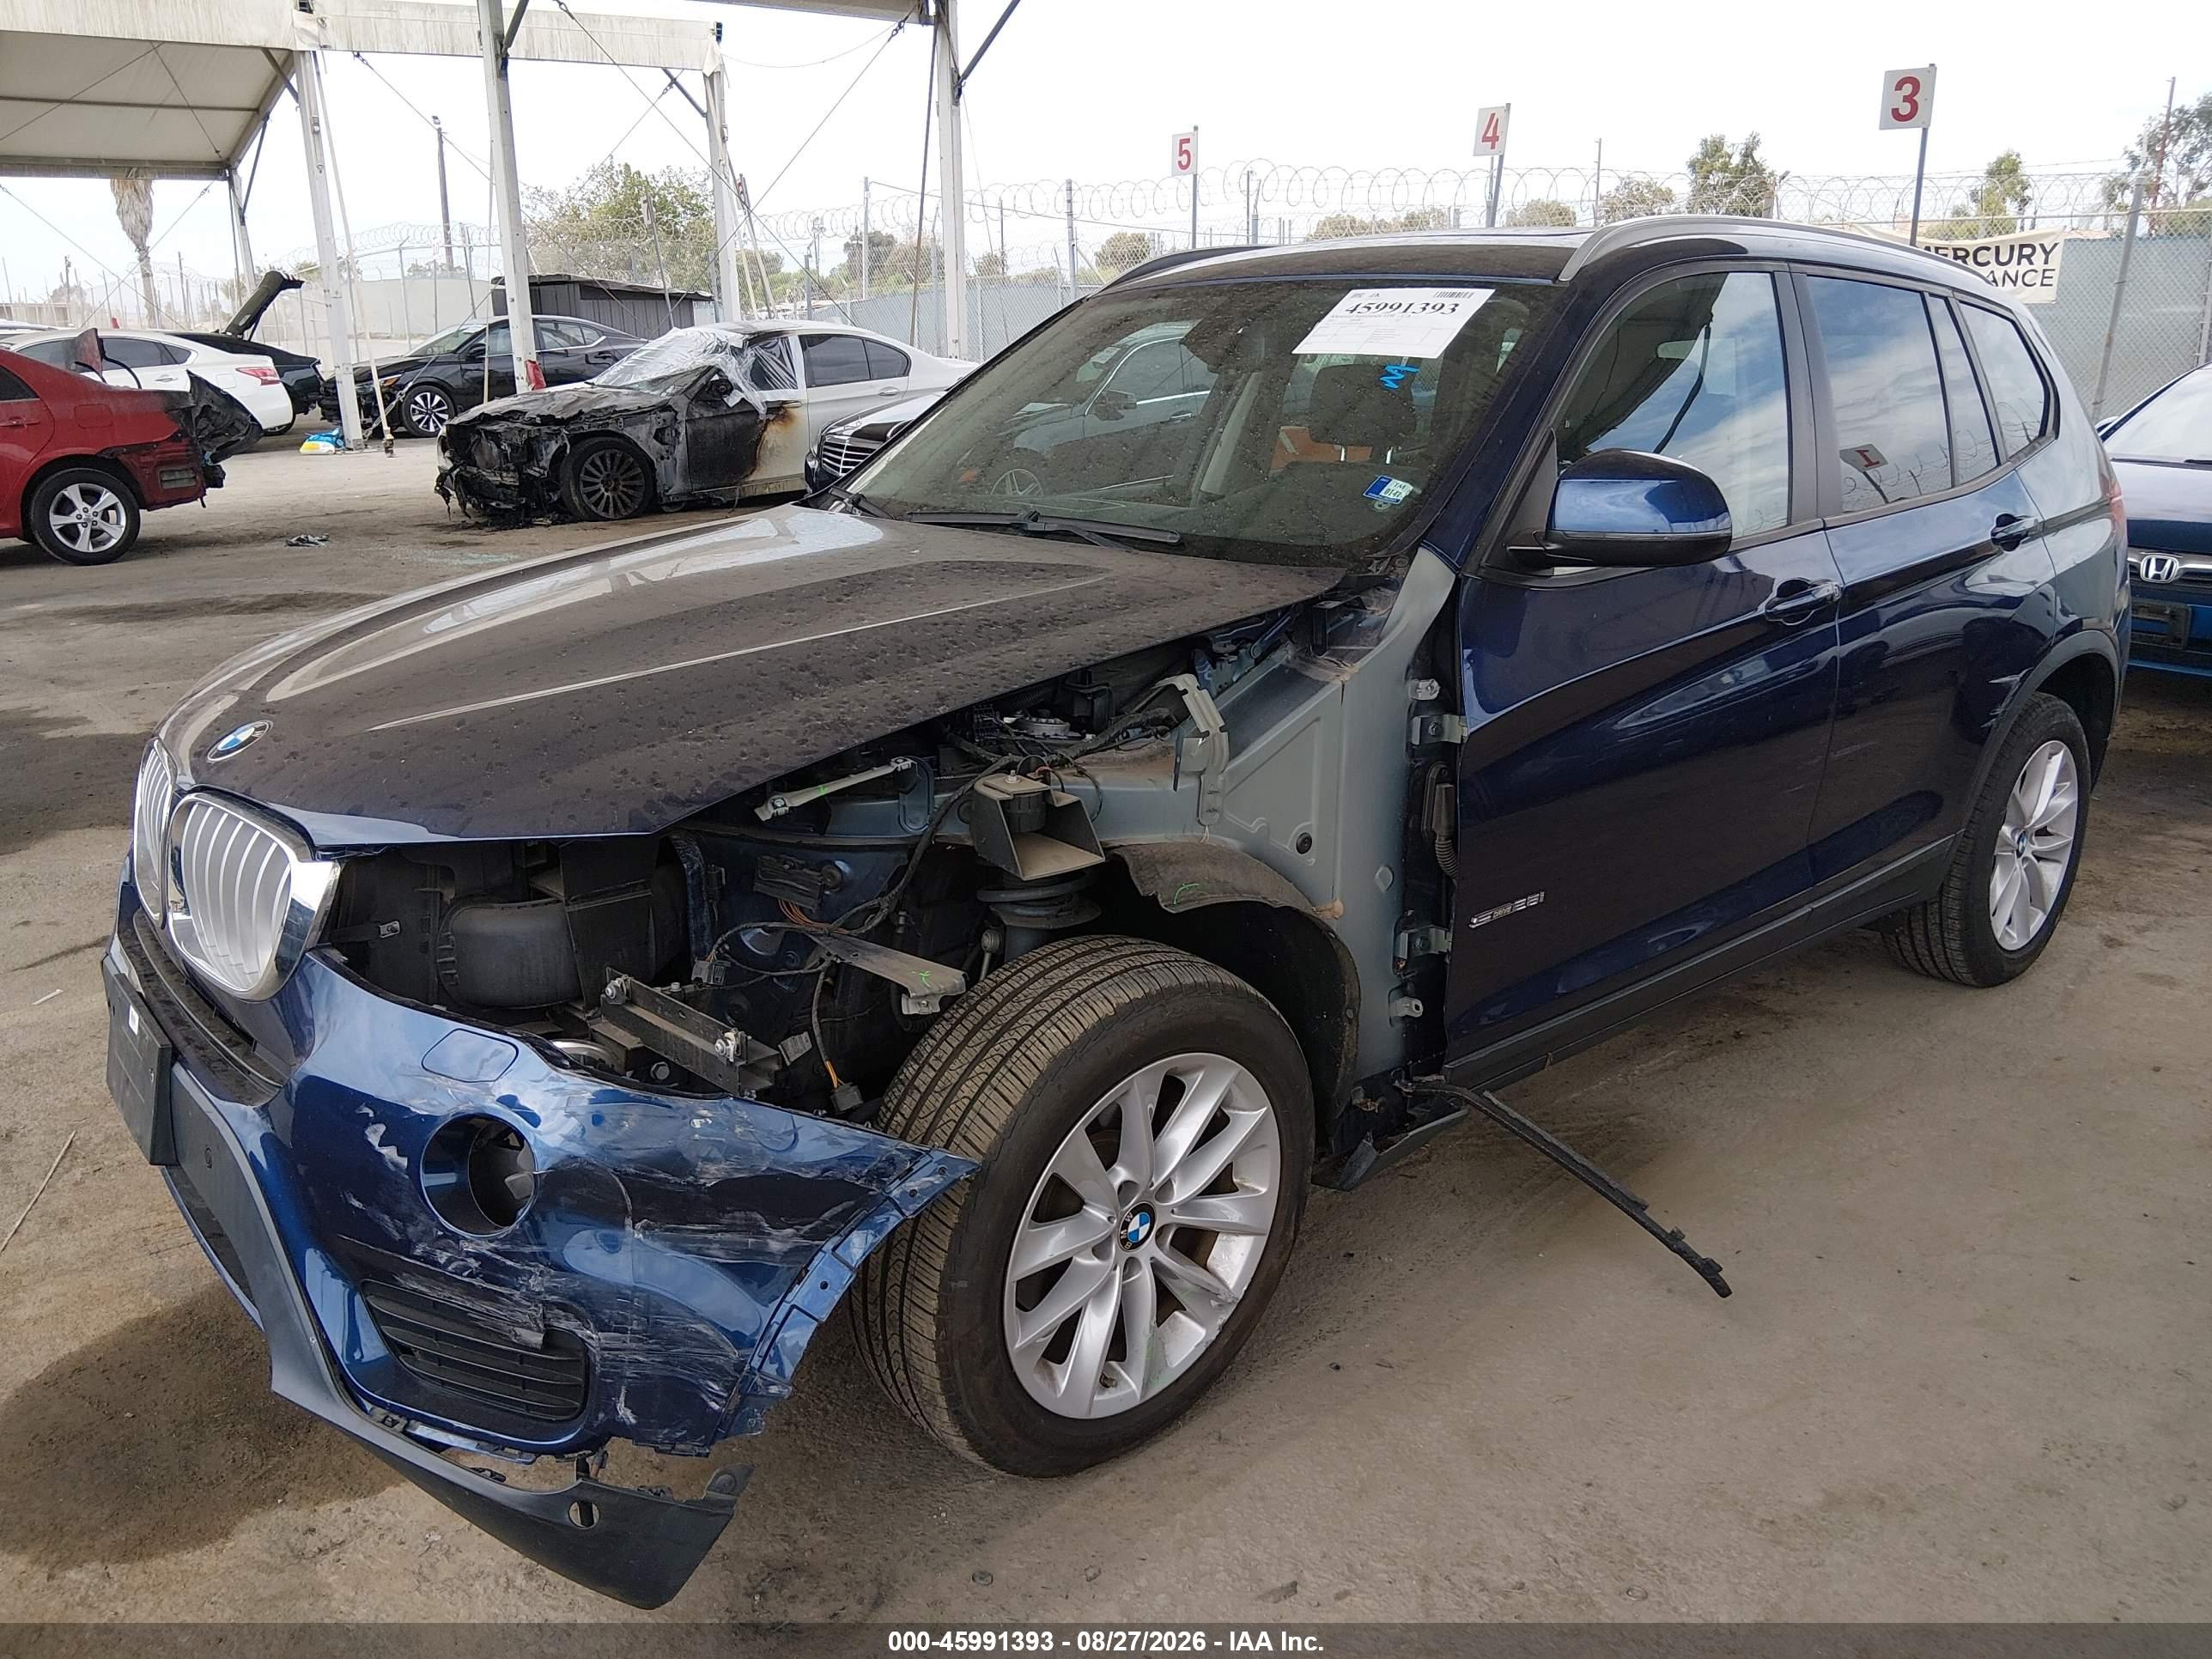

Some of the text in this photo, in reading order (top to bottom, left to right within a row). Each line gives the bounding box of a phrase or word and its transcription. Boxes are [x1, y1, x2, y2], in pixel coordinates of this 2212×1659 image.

[1891, 76, 1921, 123] 3
[1481, 112, 1499, 149] 4
[1177, 137, 1191, 170] 5
[1345, 301, 1460, 315] 45991393
